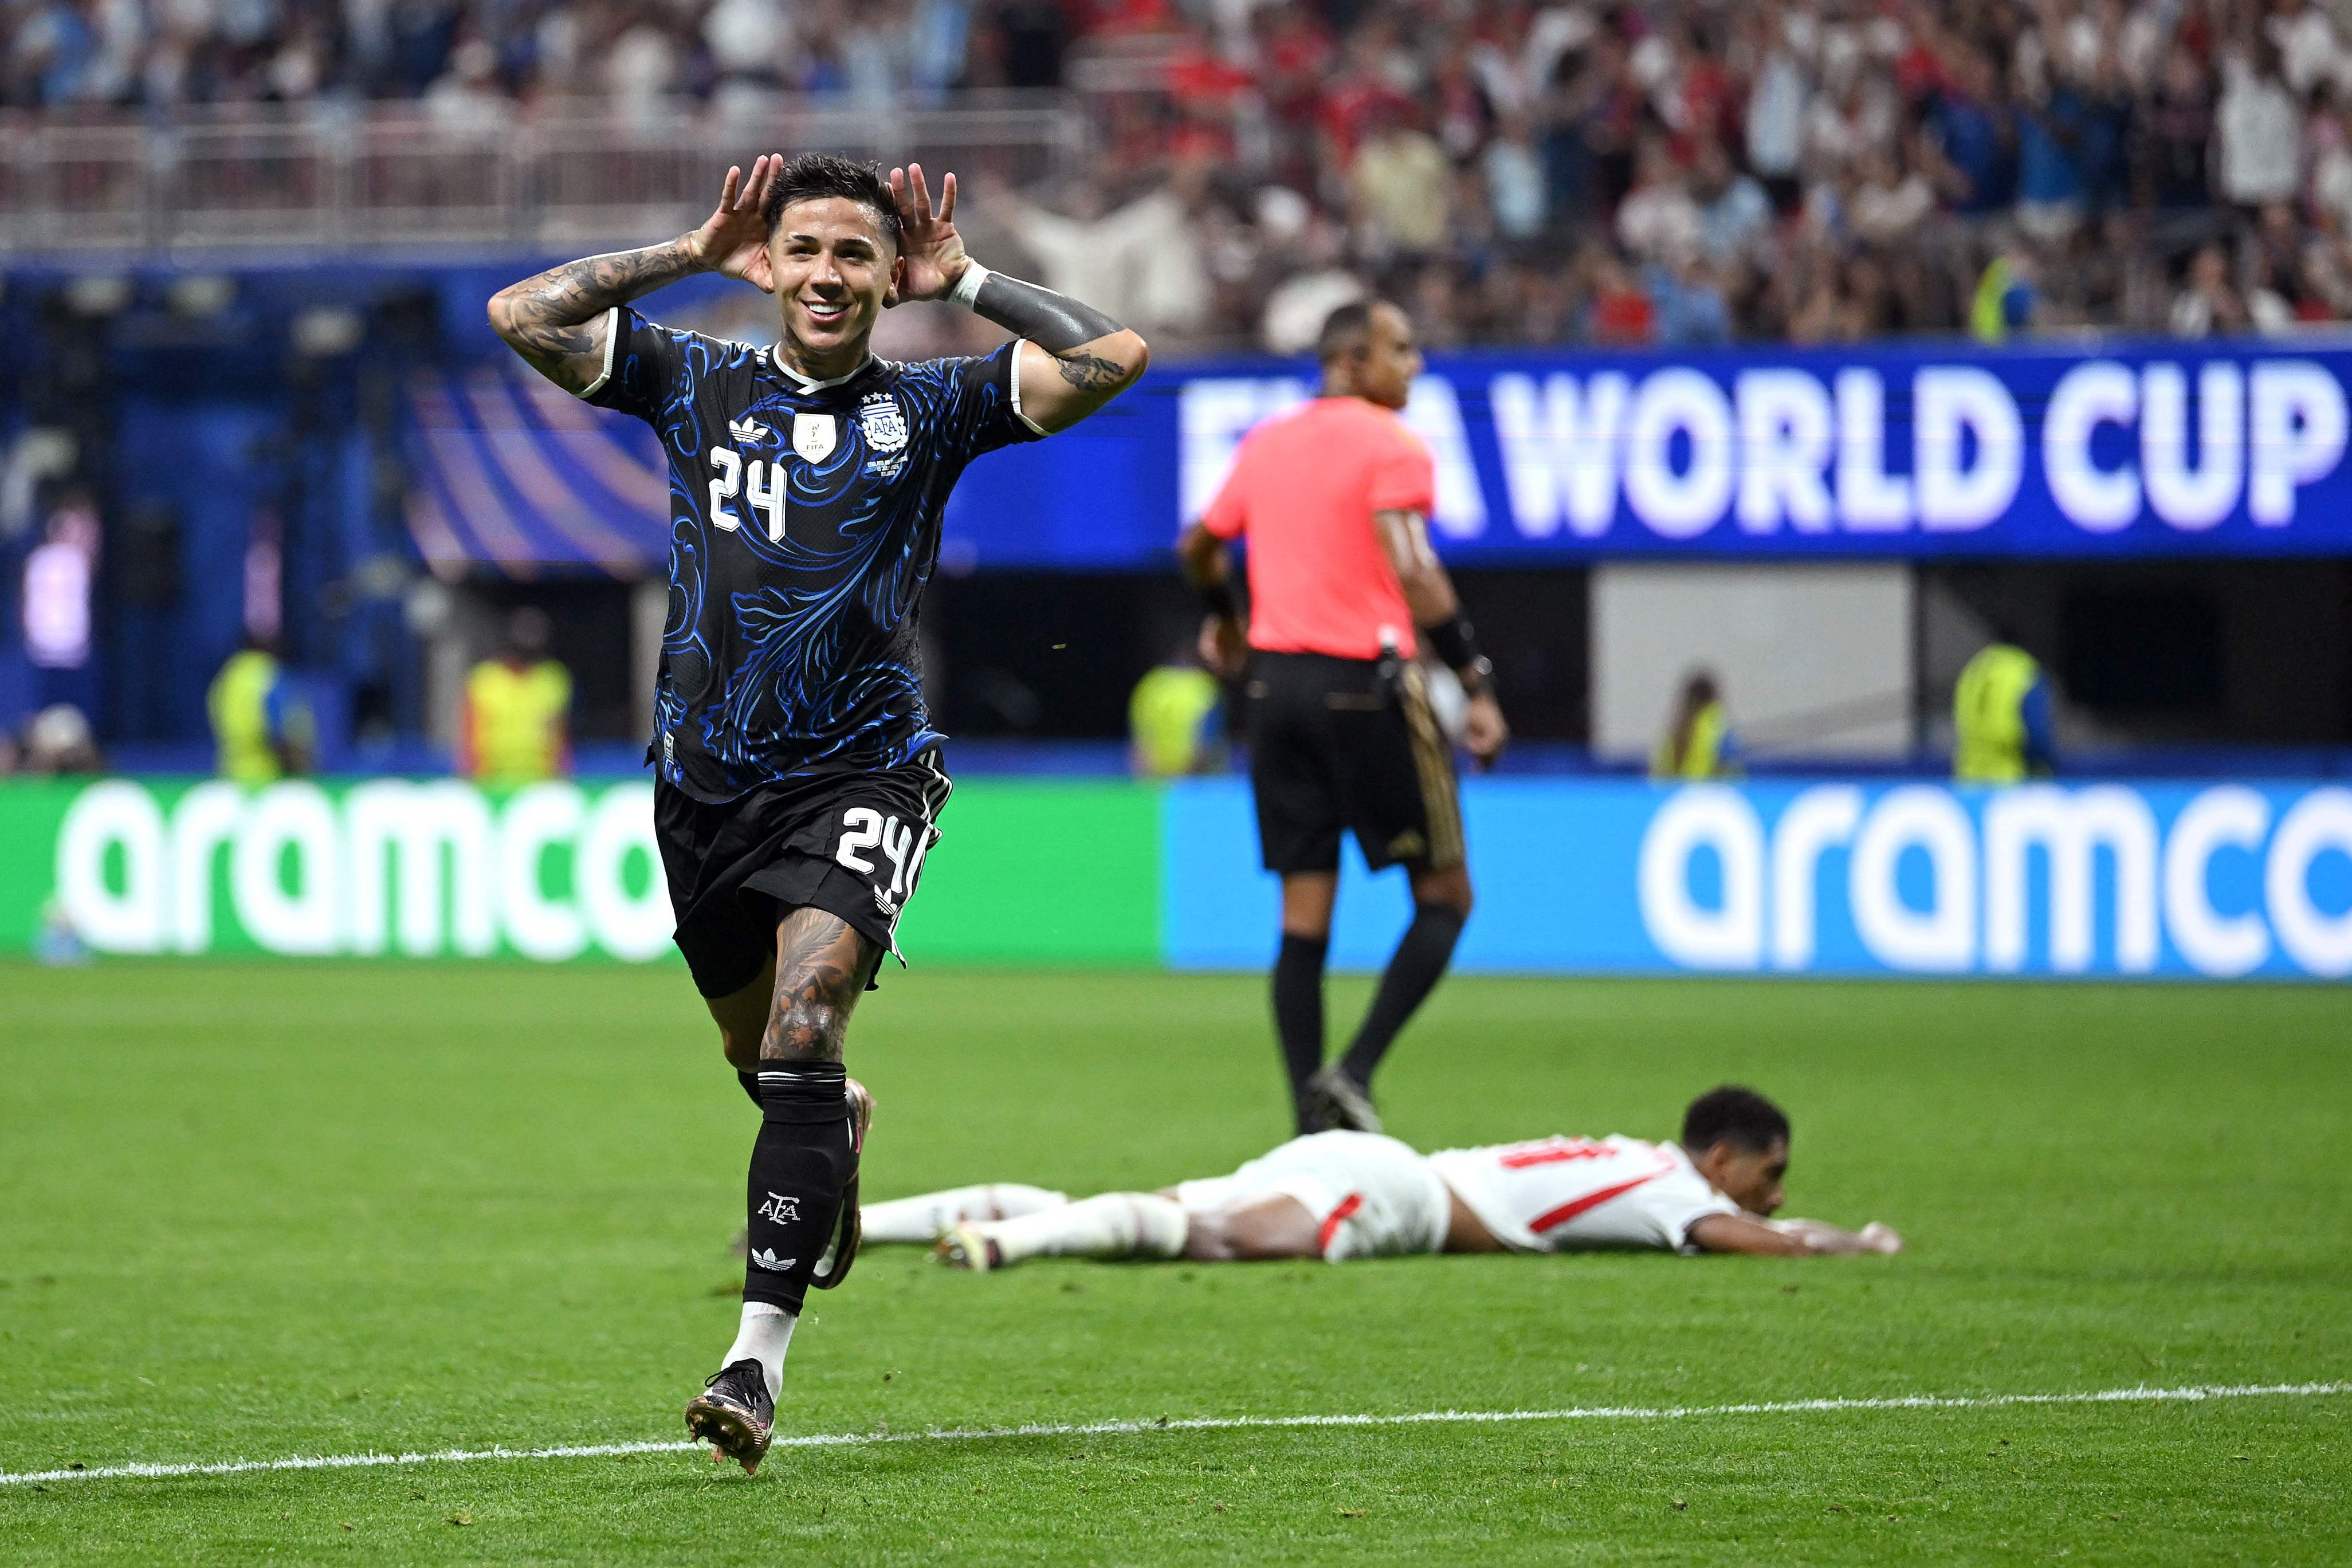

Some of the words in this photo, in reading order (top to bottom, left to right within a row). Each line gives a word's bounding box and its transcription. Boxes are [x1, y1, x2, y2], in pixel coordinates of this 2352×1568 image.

[874, 415, 897, 436] AFA
[1178, 375, 1489, 539] FA
[1490, 367, 2024, 540] WORLD
[2042, 362, 2347, 530] CUP
[709, 446, 787, 543] 24
[55, 779, 676, 961] aramco
[835, 807, 913, 894] 24
[1638, 783, 2352, 976] aramco
[757, 1191, 800, 1225] AFA
